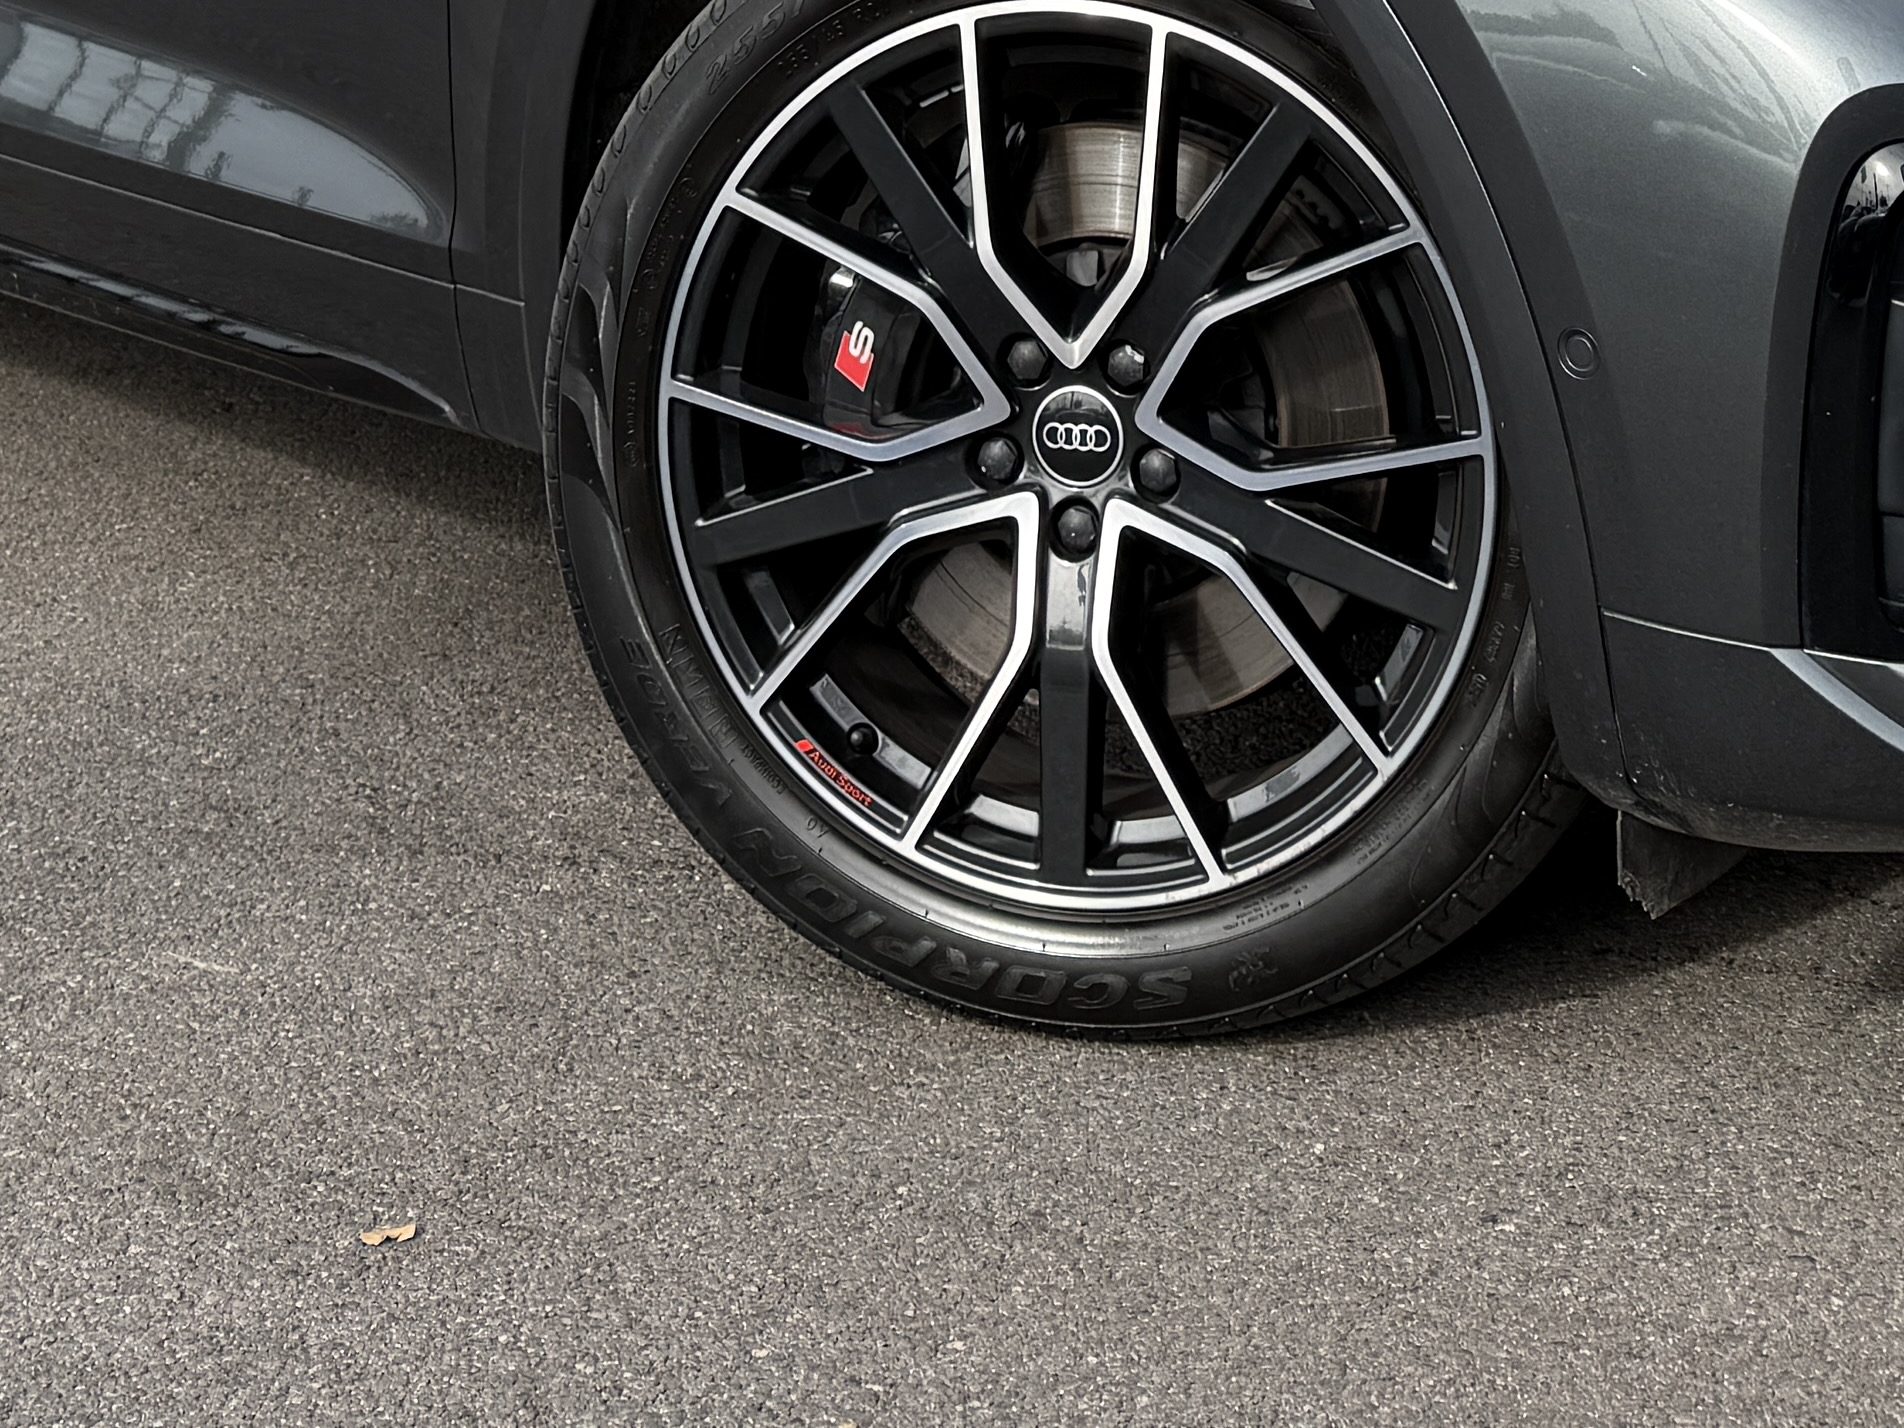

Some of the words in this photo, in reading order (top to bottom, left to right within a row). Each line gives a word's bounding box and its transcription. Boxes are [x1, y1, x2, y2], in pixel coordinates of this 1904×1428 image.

[848, 320, 875, 364] S
[618, 636, 731, 808] VERDE
[809, 751, 837, 779] Audi
[836, 775, 873, 806] Sport
[735, 826, 1195, 1012] SCORPION
